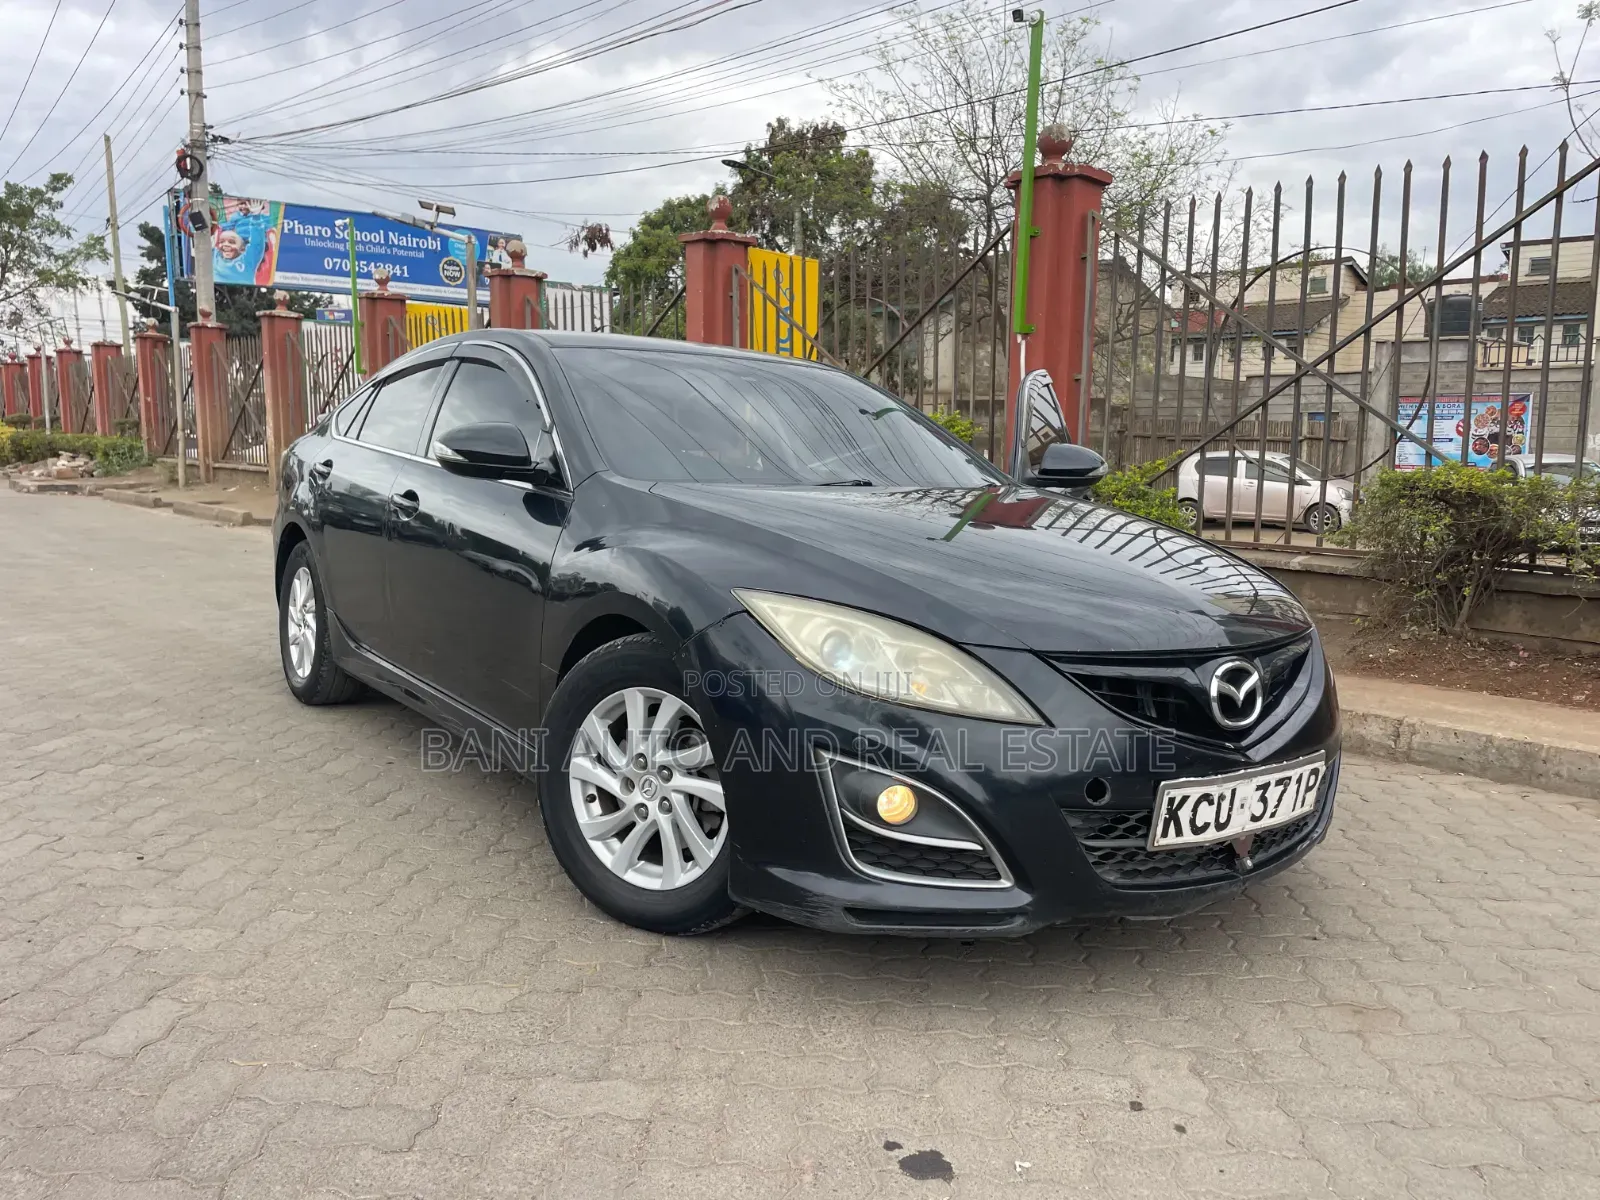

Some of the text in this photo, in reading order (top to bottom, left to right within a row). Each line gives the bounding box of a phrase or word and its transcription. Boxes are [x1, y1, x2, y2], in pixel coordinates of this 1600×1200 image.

[283, 219, 441, 251] Pharo School Nairobi
[304, 237, 425, 258] Unlocking Ech Child's Potential
[444, 270, 461, 278] NOW
[1160, 767, 1320, 838] KCU 371P
